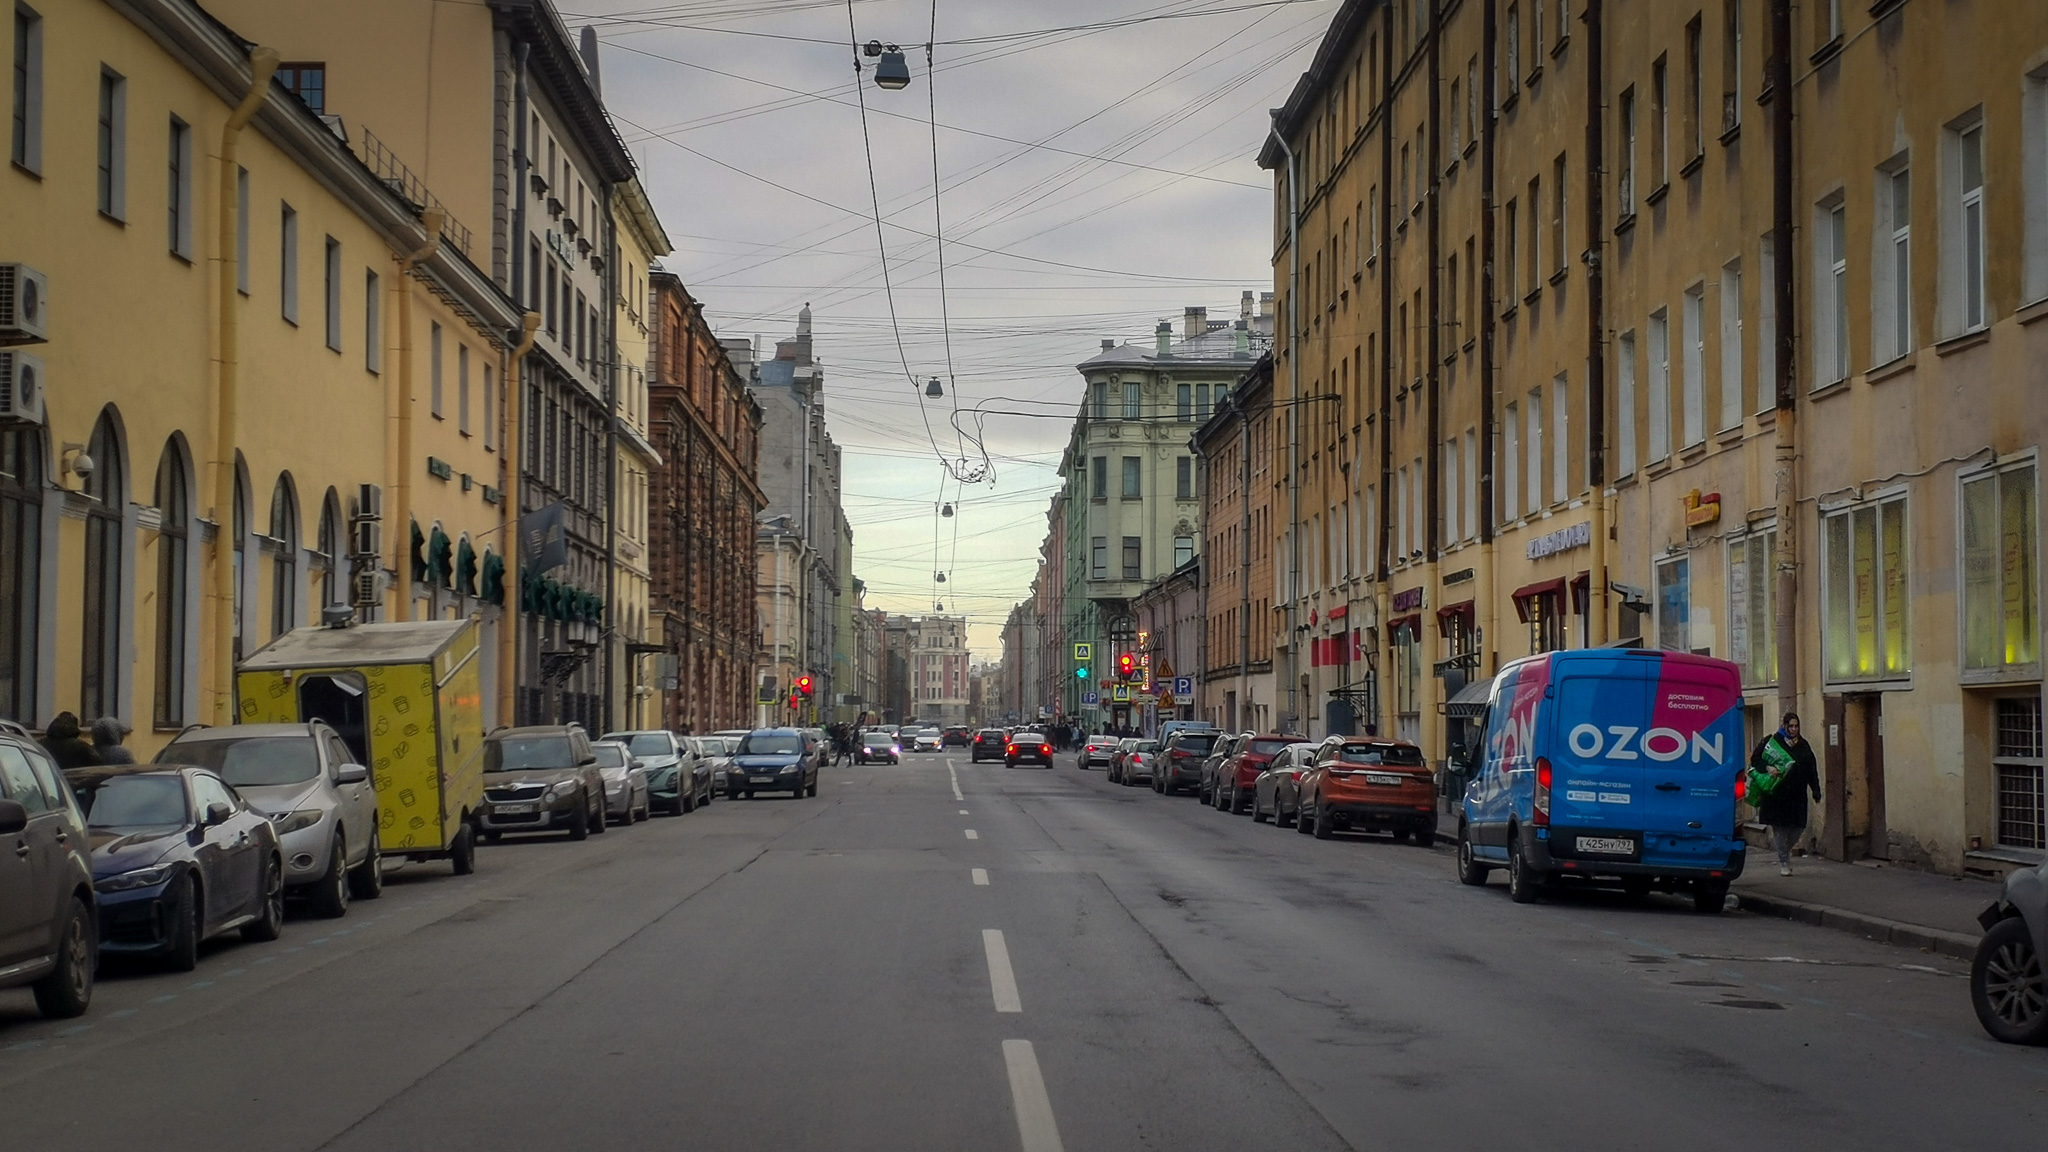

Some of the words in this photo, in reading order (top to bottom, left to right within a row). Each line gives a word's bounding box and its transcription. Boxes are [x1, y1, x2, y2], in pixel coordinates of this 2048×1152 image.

[1179, 679, 1189, 693] P
[1668, 701, 1709, 711] бесплатно
[1568, 723, 1724, 765] OZON
